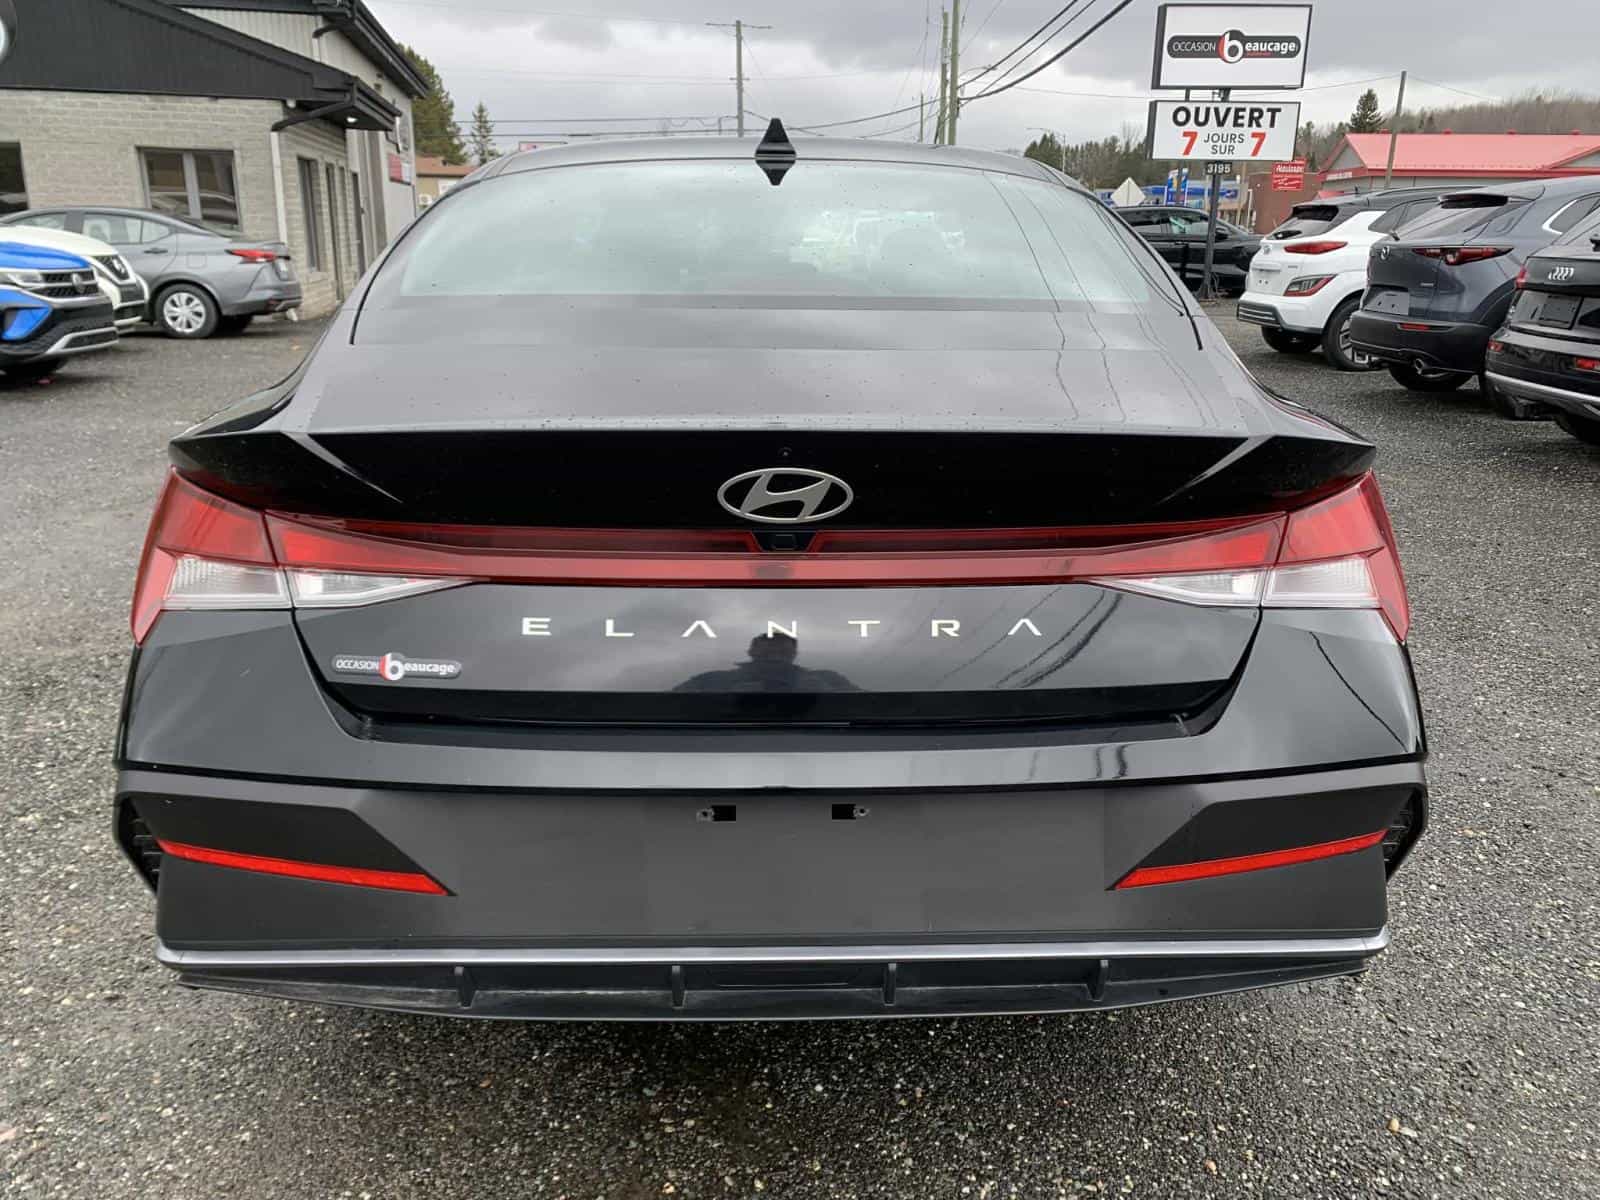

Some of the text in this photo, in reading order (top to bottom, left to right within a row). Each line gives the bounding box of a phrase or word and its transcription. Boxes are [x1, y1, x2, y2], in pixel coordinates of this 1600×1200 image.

[1172, 41, 1216, 52] OCCASION
[1172, 106, 1282, 128] OUVERT
[1181, 131, 1245, 156] 7 JOURS
[1211, 132, 1266, 157] SUR 7
[1207, 163, 1231, 174] 3195
[521, 616, 1043, 639] ELANTRA
[335, 659, 380, 671] OCCASION
